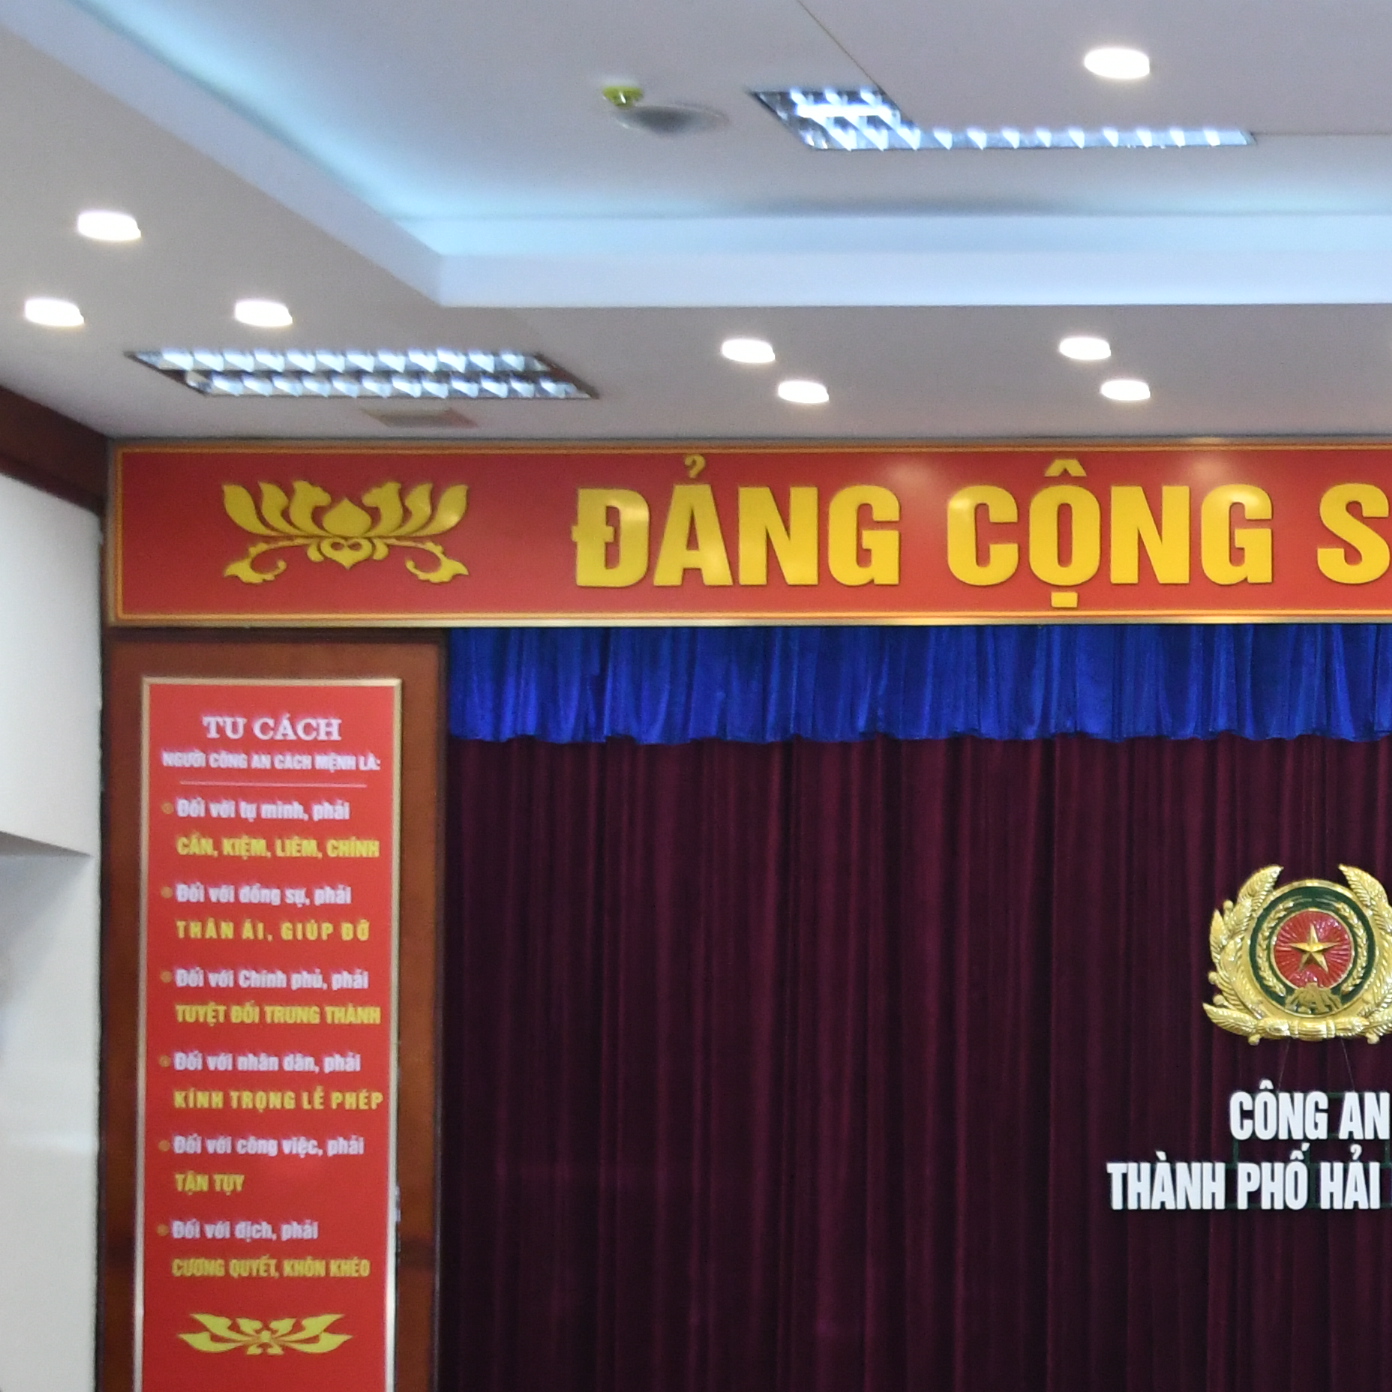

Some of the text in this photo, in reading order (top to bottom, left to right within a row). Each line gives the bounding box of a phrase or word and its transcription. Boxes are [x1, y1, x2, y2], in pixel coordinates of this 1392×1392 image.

[572, 454, 901, 589] ĐẢNG
[946, 458, 1275, 609] CỘNG
[1229, 1079, 1391, 1141] CÔNG AN
[1106, 1150, 1226, 1210] THÀNH
[1236, 1142, 1311, 1211] PHỐ
[1319, 1143, 1381, 1210] HẢI
